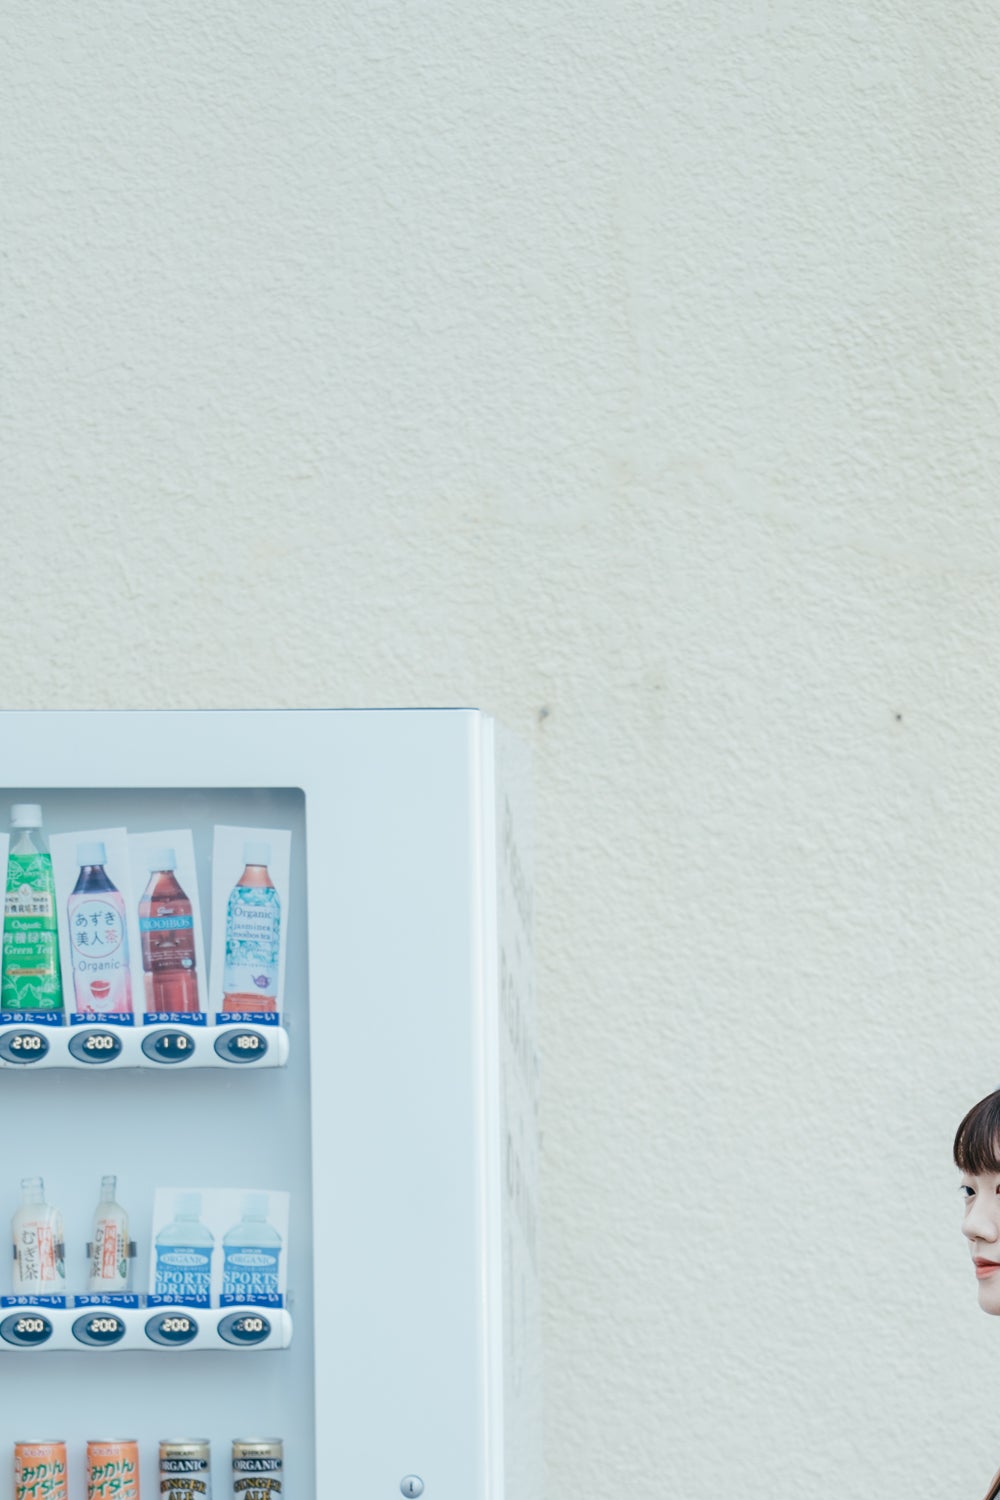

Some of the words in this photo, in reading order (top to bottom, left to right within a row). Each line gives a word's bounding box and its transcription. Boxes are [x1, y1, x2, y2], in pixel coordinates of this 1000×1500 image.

[75, 911, 116, 927] あずき
[234, 907, 272, 919] Organic
[77, 930, 118, 946] 美人茶
[78, 959, 120, 972] Organic
[12, 1036, 41, 1050] 200
[86, 1036, 113, 1049] 200
[164, 1036, 187, 1049] 10
[237, 1036, 259, 1049] 180
[155, 1271, 211, 1284] SPORTS
[223, 1271, 279, 1284] SPORTS
[157, 1283, 208, 1295] DRINK
[225, 1283, 276, 1294] DRINK
[17, 1319, 44, 1332] 200
[91, 1319, 117, 1332] 200
[162, 1318, 189, 1332] 200
[22, 1459, 65, 1482] みかん
[91, 1458, 135, 1481] みかん
[234, 1460, 280, 1471] ORGANIC
[233, 1478, 281, 1493] GINGER
